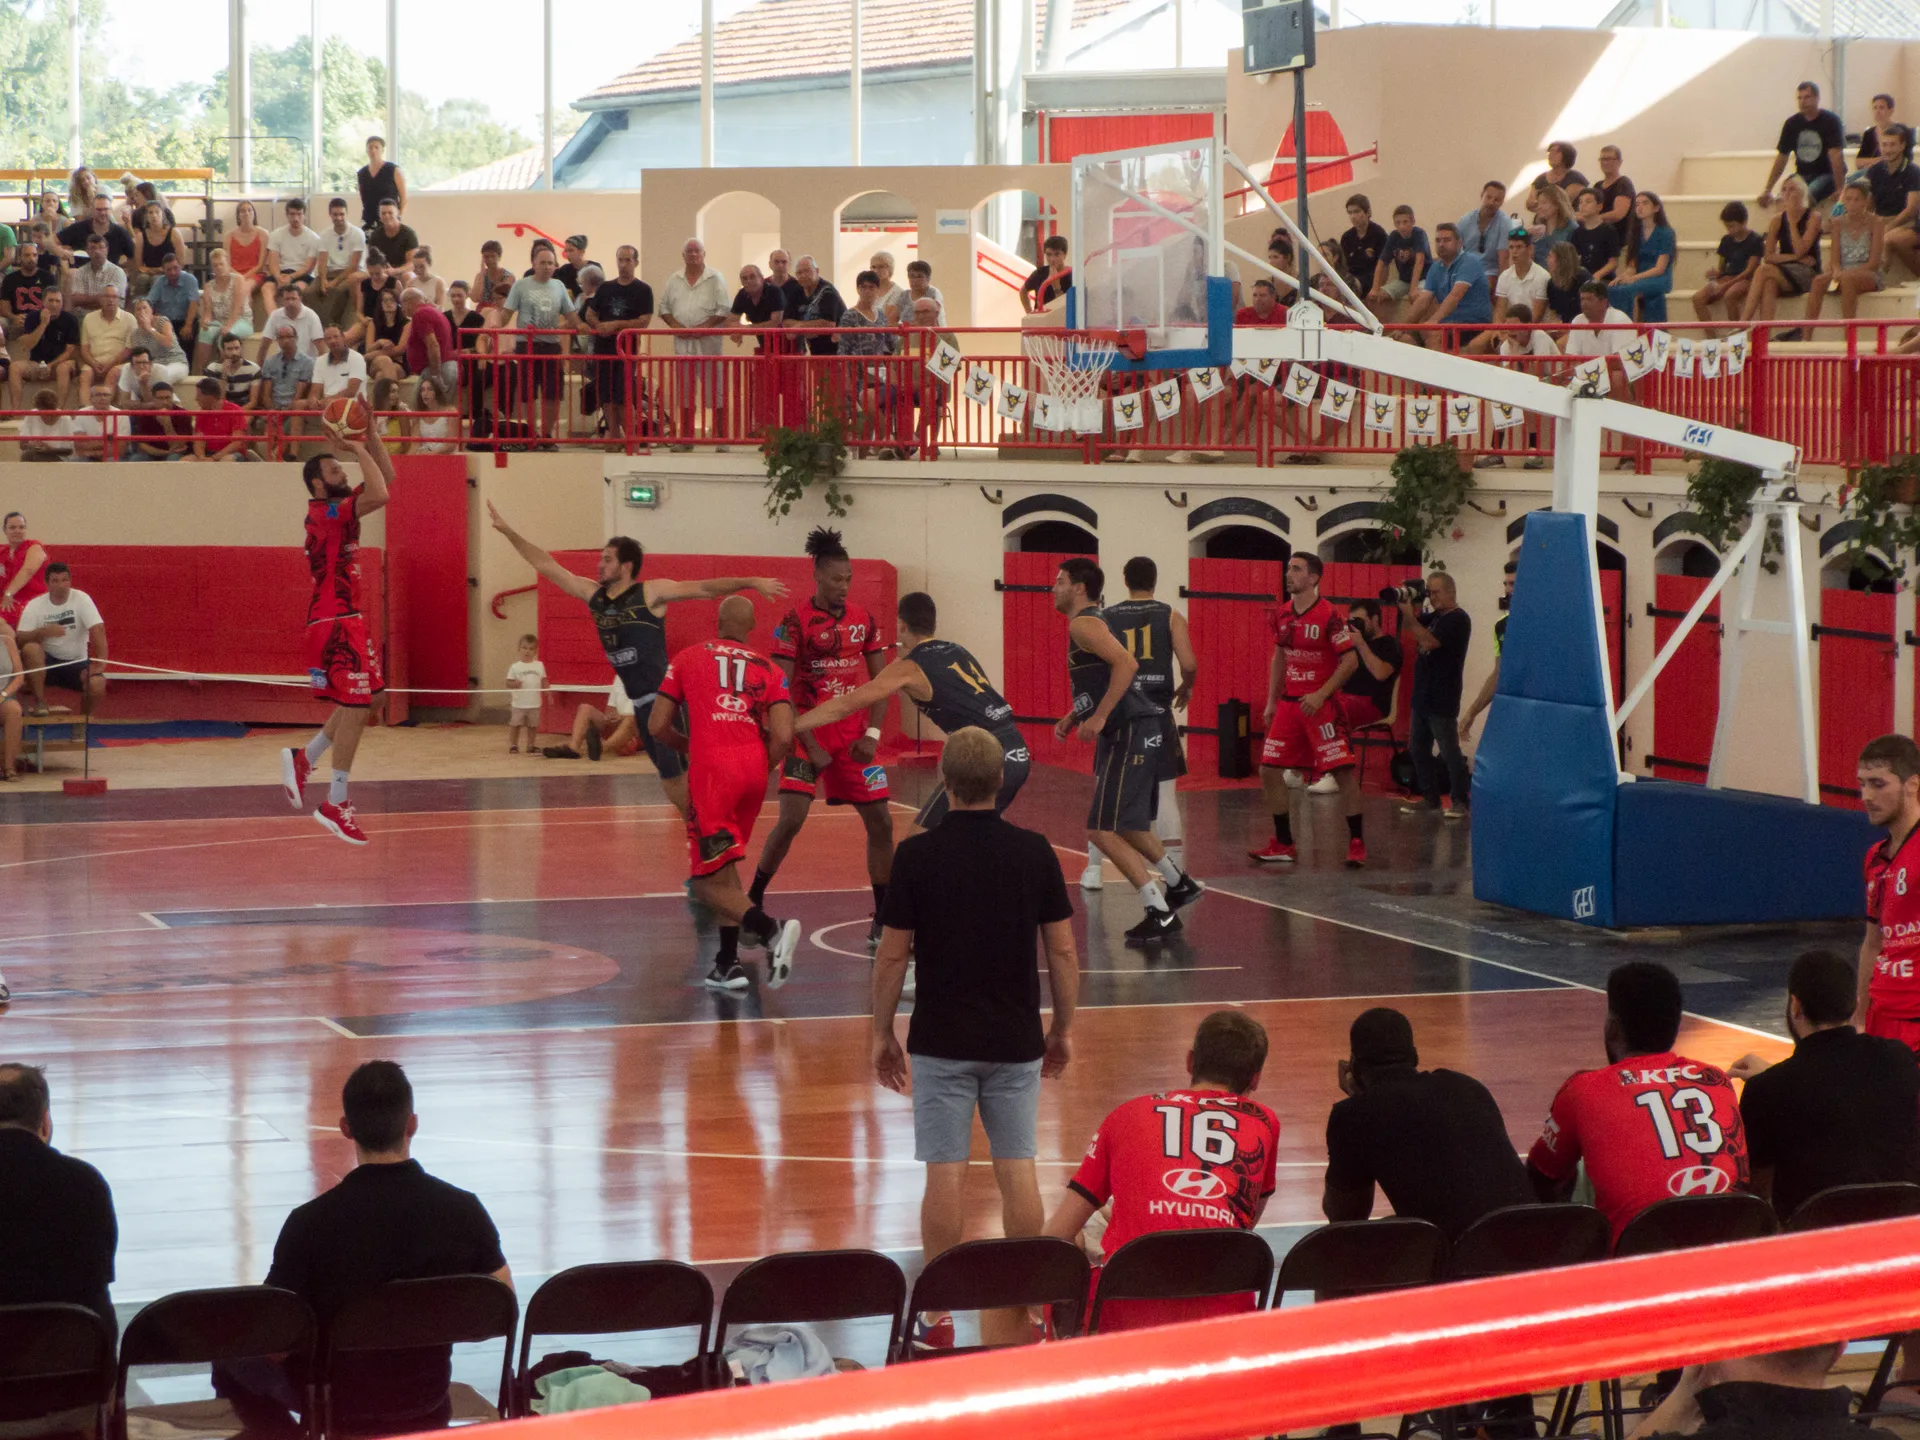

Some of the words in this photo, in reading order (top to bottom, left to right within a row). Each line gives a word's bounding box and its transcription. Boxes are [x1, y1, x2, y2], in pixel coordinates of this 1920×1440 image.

[848, 624, 866, 642] 23
[1122, 623, 1155, 660] 11
[1304, 623, 1320, 640] 10
[716, 645, 756, 659] KFC
[714, 655, 746, 692] 11
[811, 659, 849, 668] GRAND
[1320, 722, 1336, 740] 10
[1896, 867, 1908, 896] 8
[1573, 887, 1595, 918] GES
[1639, 1064, 1703, 1084] KFC
[1169, 1094, 1238, 1106] KFC
[1634, 1086, 1725, 1160] 13
[1153, 1105, 1239, 1165] 16
